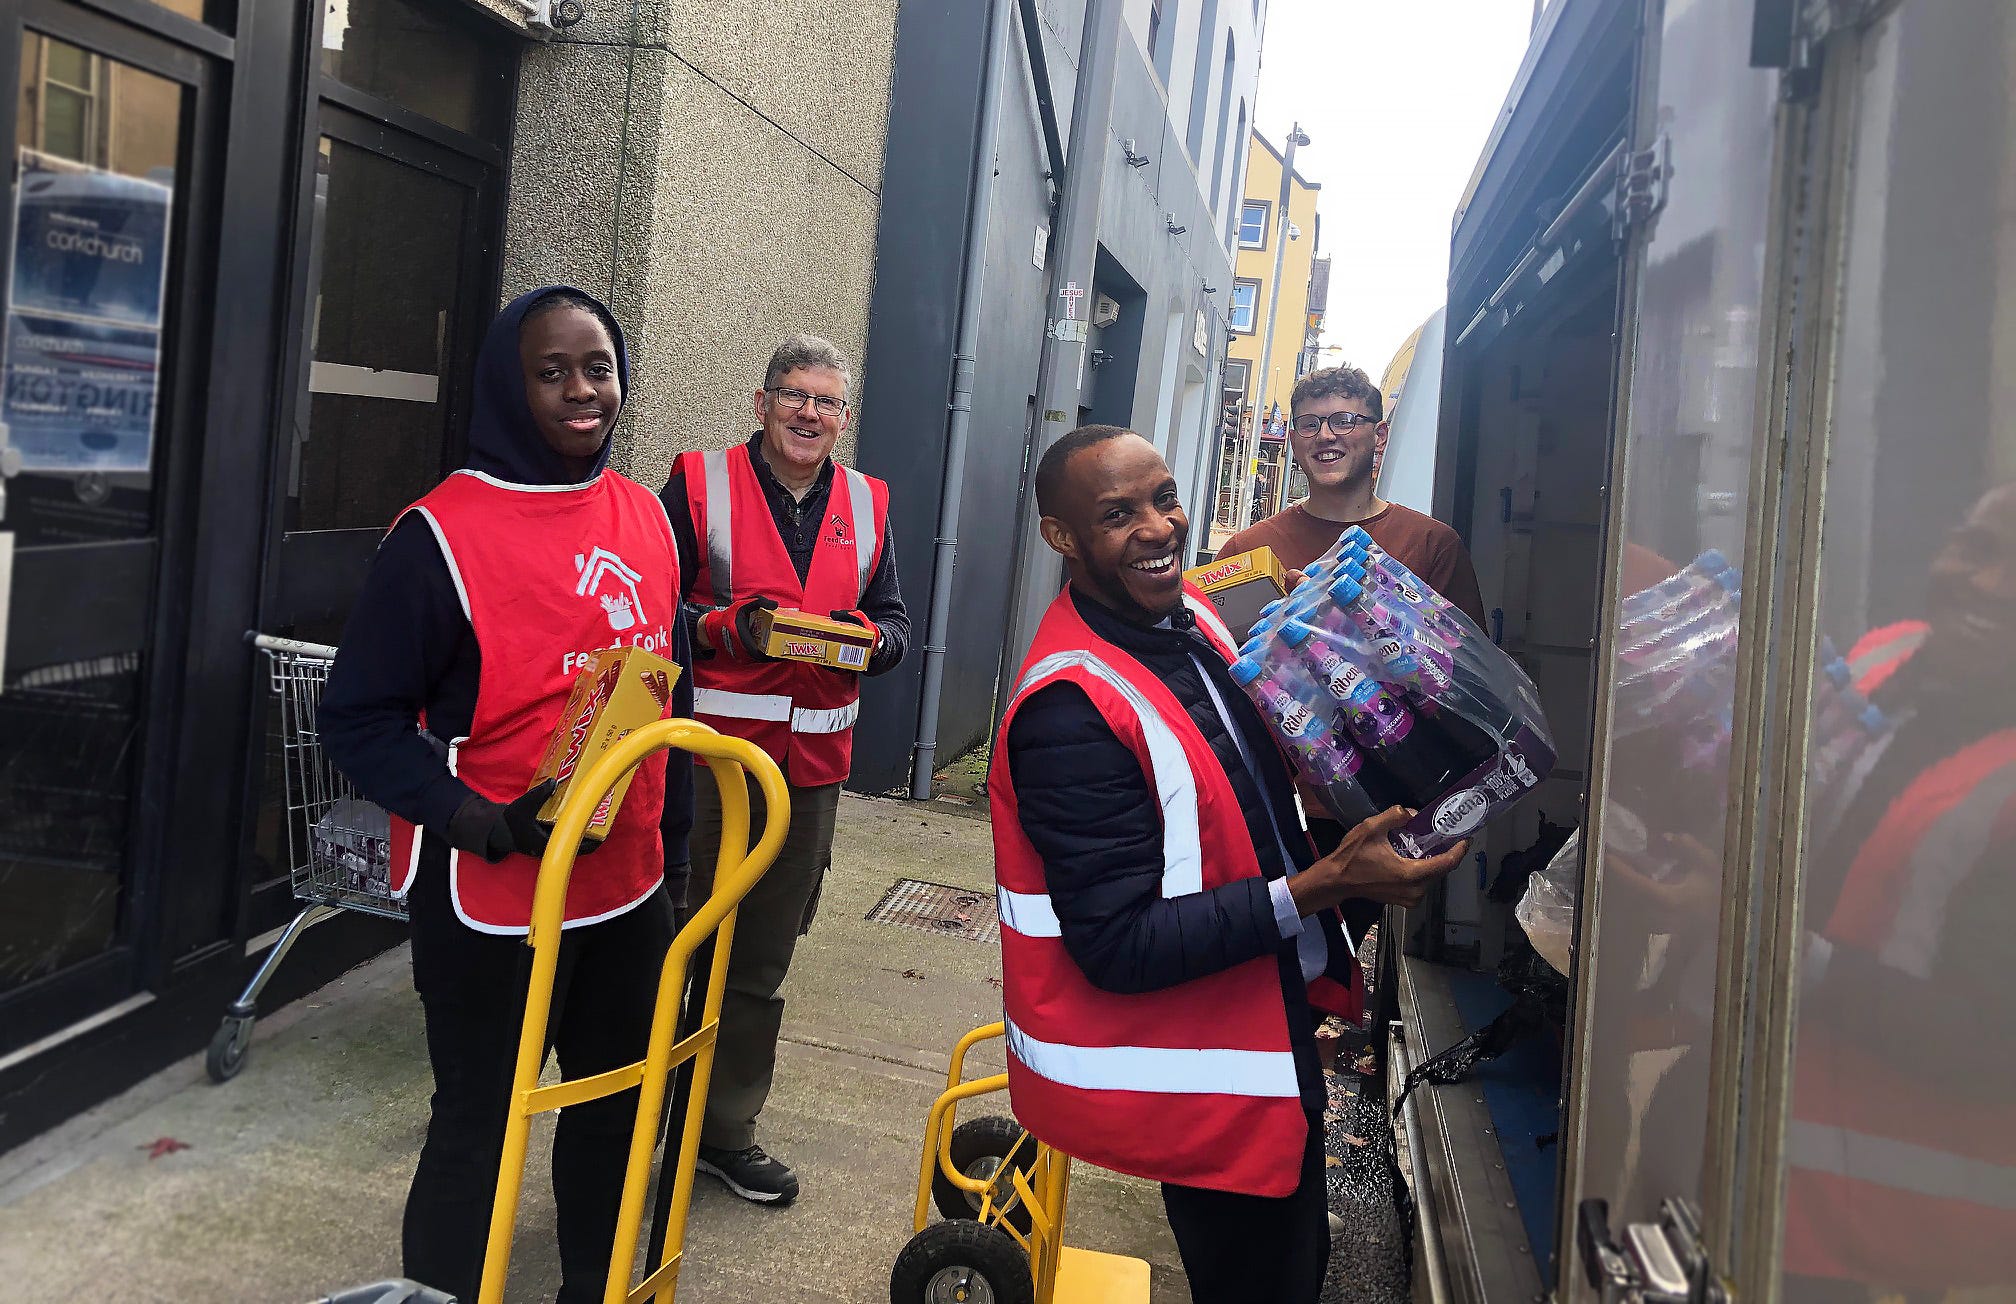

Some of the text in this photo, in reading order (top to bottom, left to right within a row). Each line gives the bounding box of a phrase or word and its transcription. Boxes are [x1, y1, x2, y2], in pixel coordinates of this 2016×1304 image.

[47, 230, 143, 265] corkchurch
[1061, 289, 1084, 297] JESUS
[1436, 794, 1485, 833] Ribena
